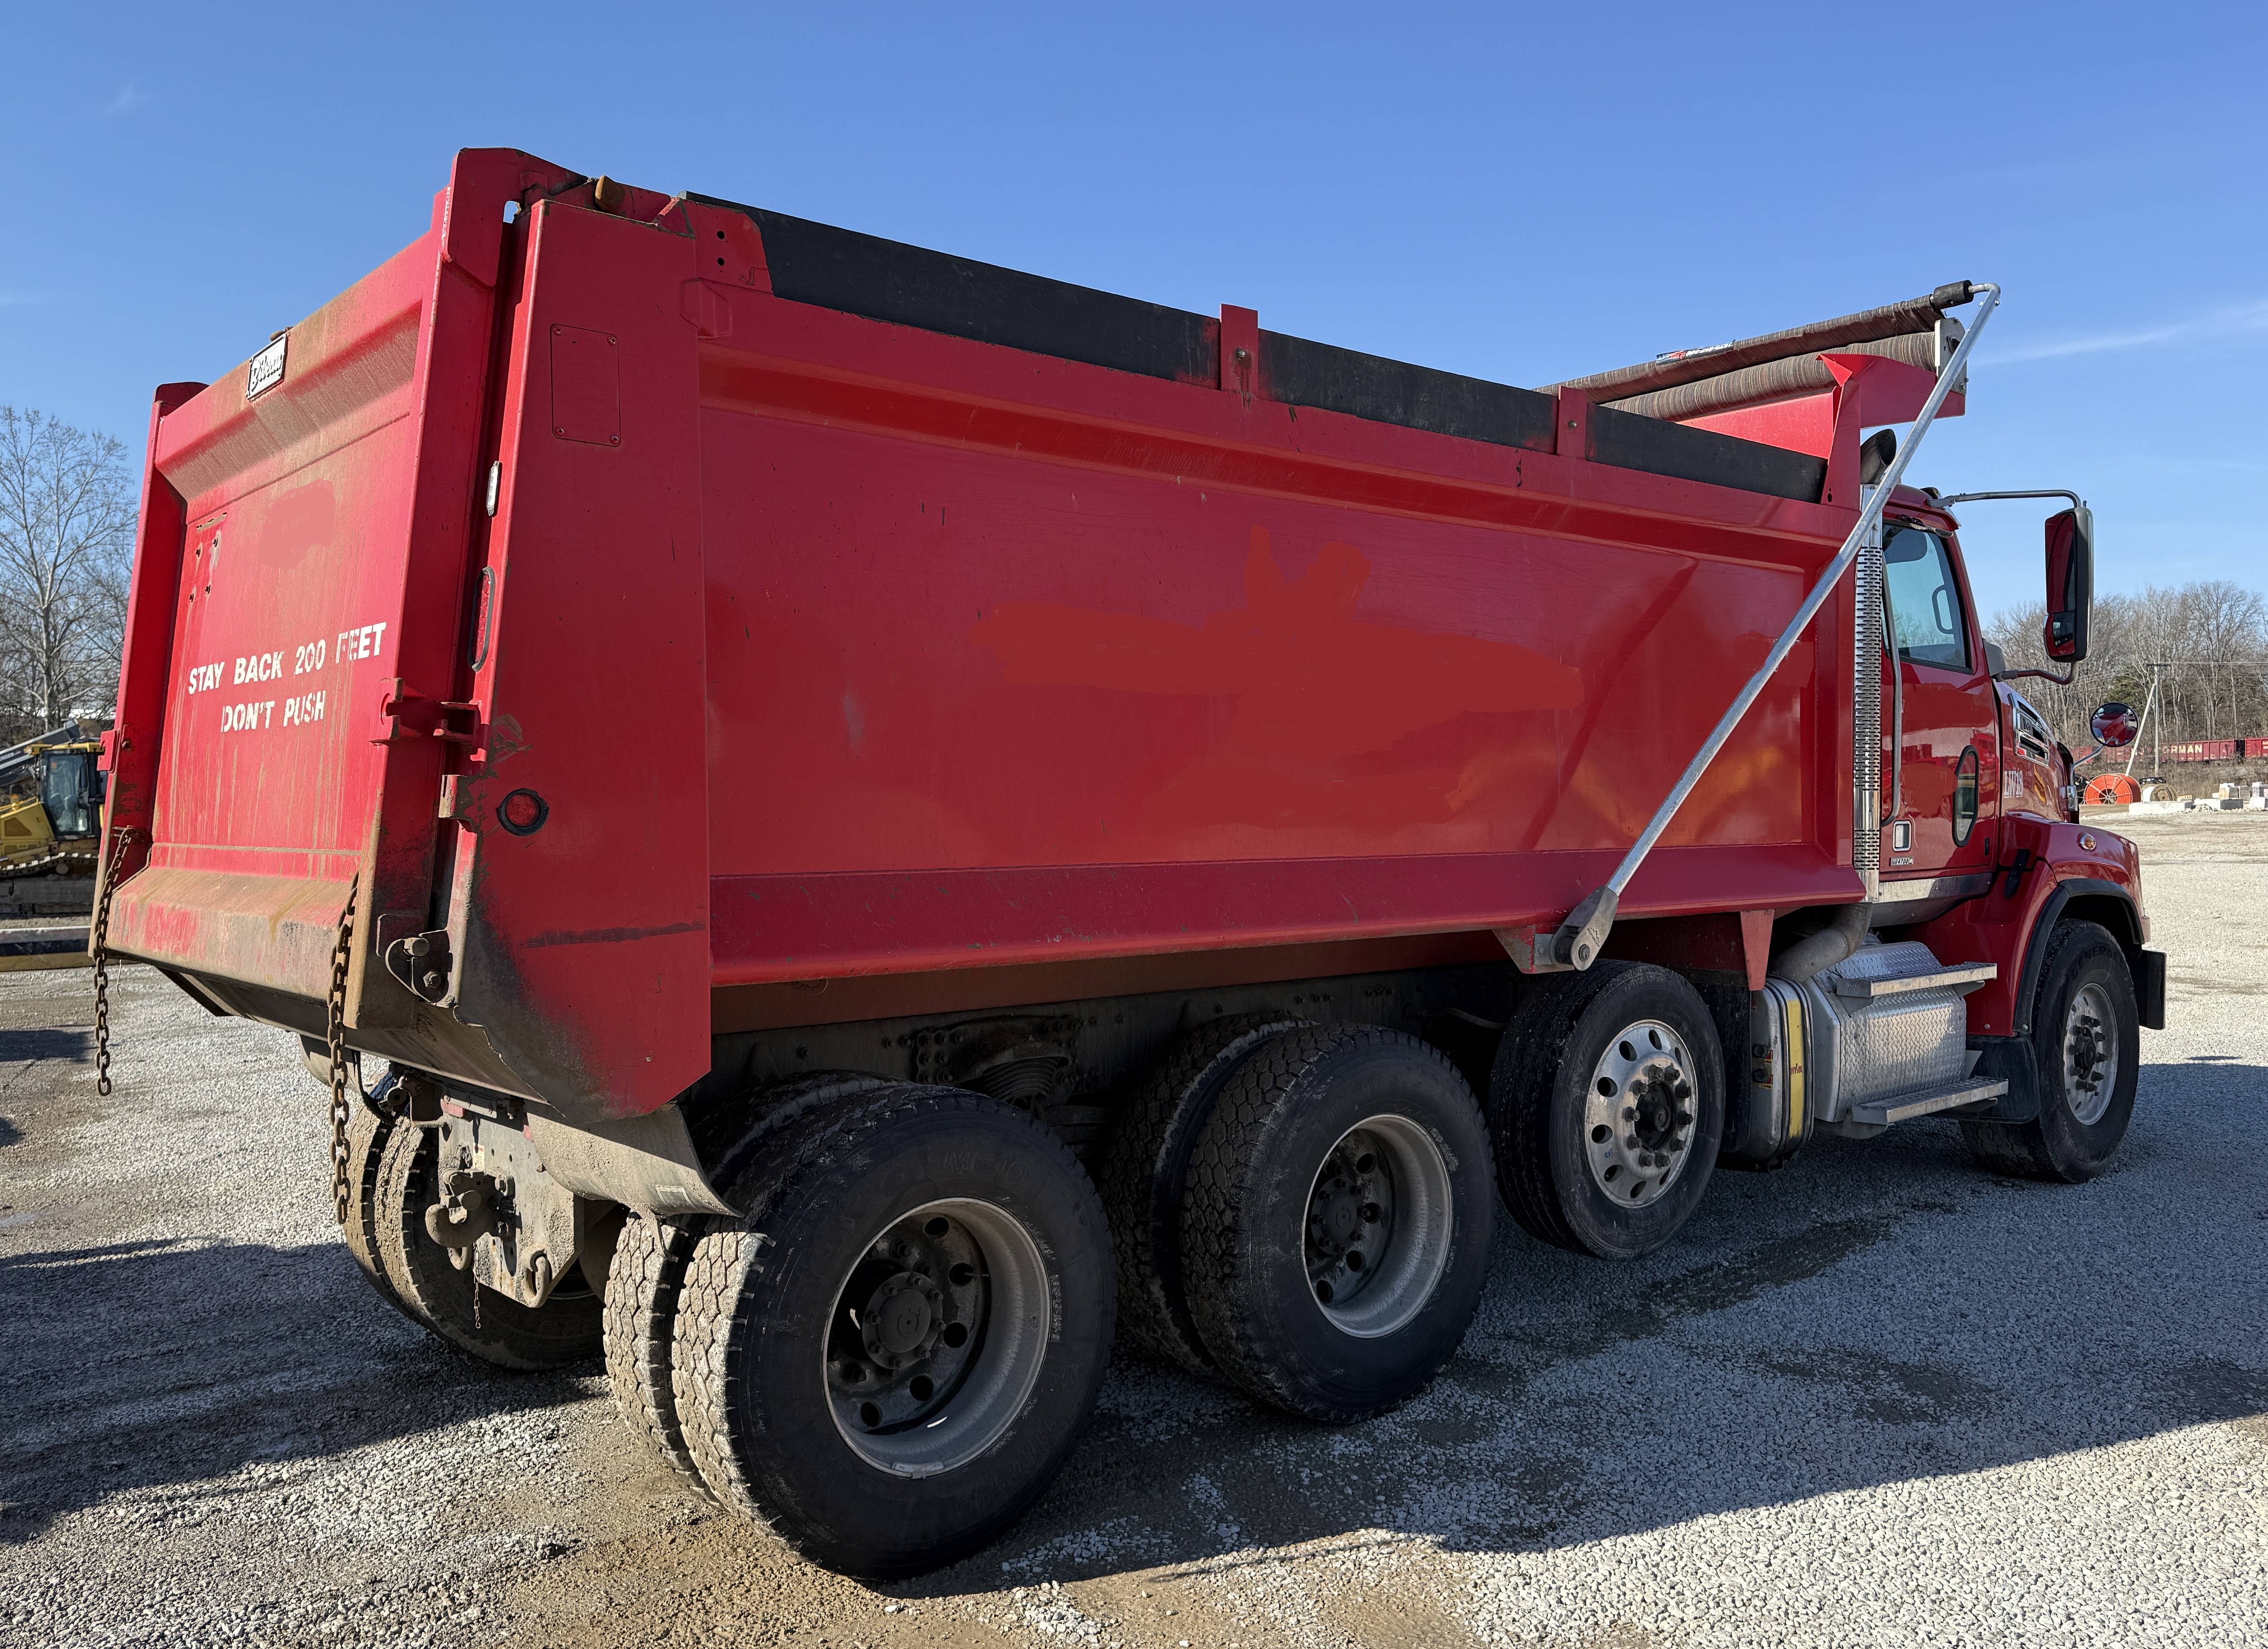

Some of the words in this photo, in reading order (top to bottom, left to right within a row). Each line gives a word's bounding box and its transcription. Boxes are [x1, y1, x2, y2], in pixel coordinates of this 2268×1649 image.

[188, 661, 225, 695] STAY
[234, 651, 285, 685] BACK
[293, 639, 326, 675] 200
[336, 622, 387, 664] FEET
[220, 700, 275, 733] DON'T
[283, 690, 326, 727] PUSH
[2003, 770, 2024, 798] LW18
